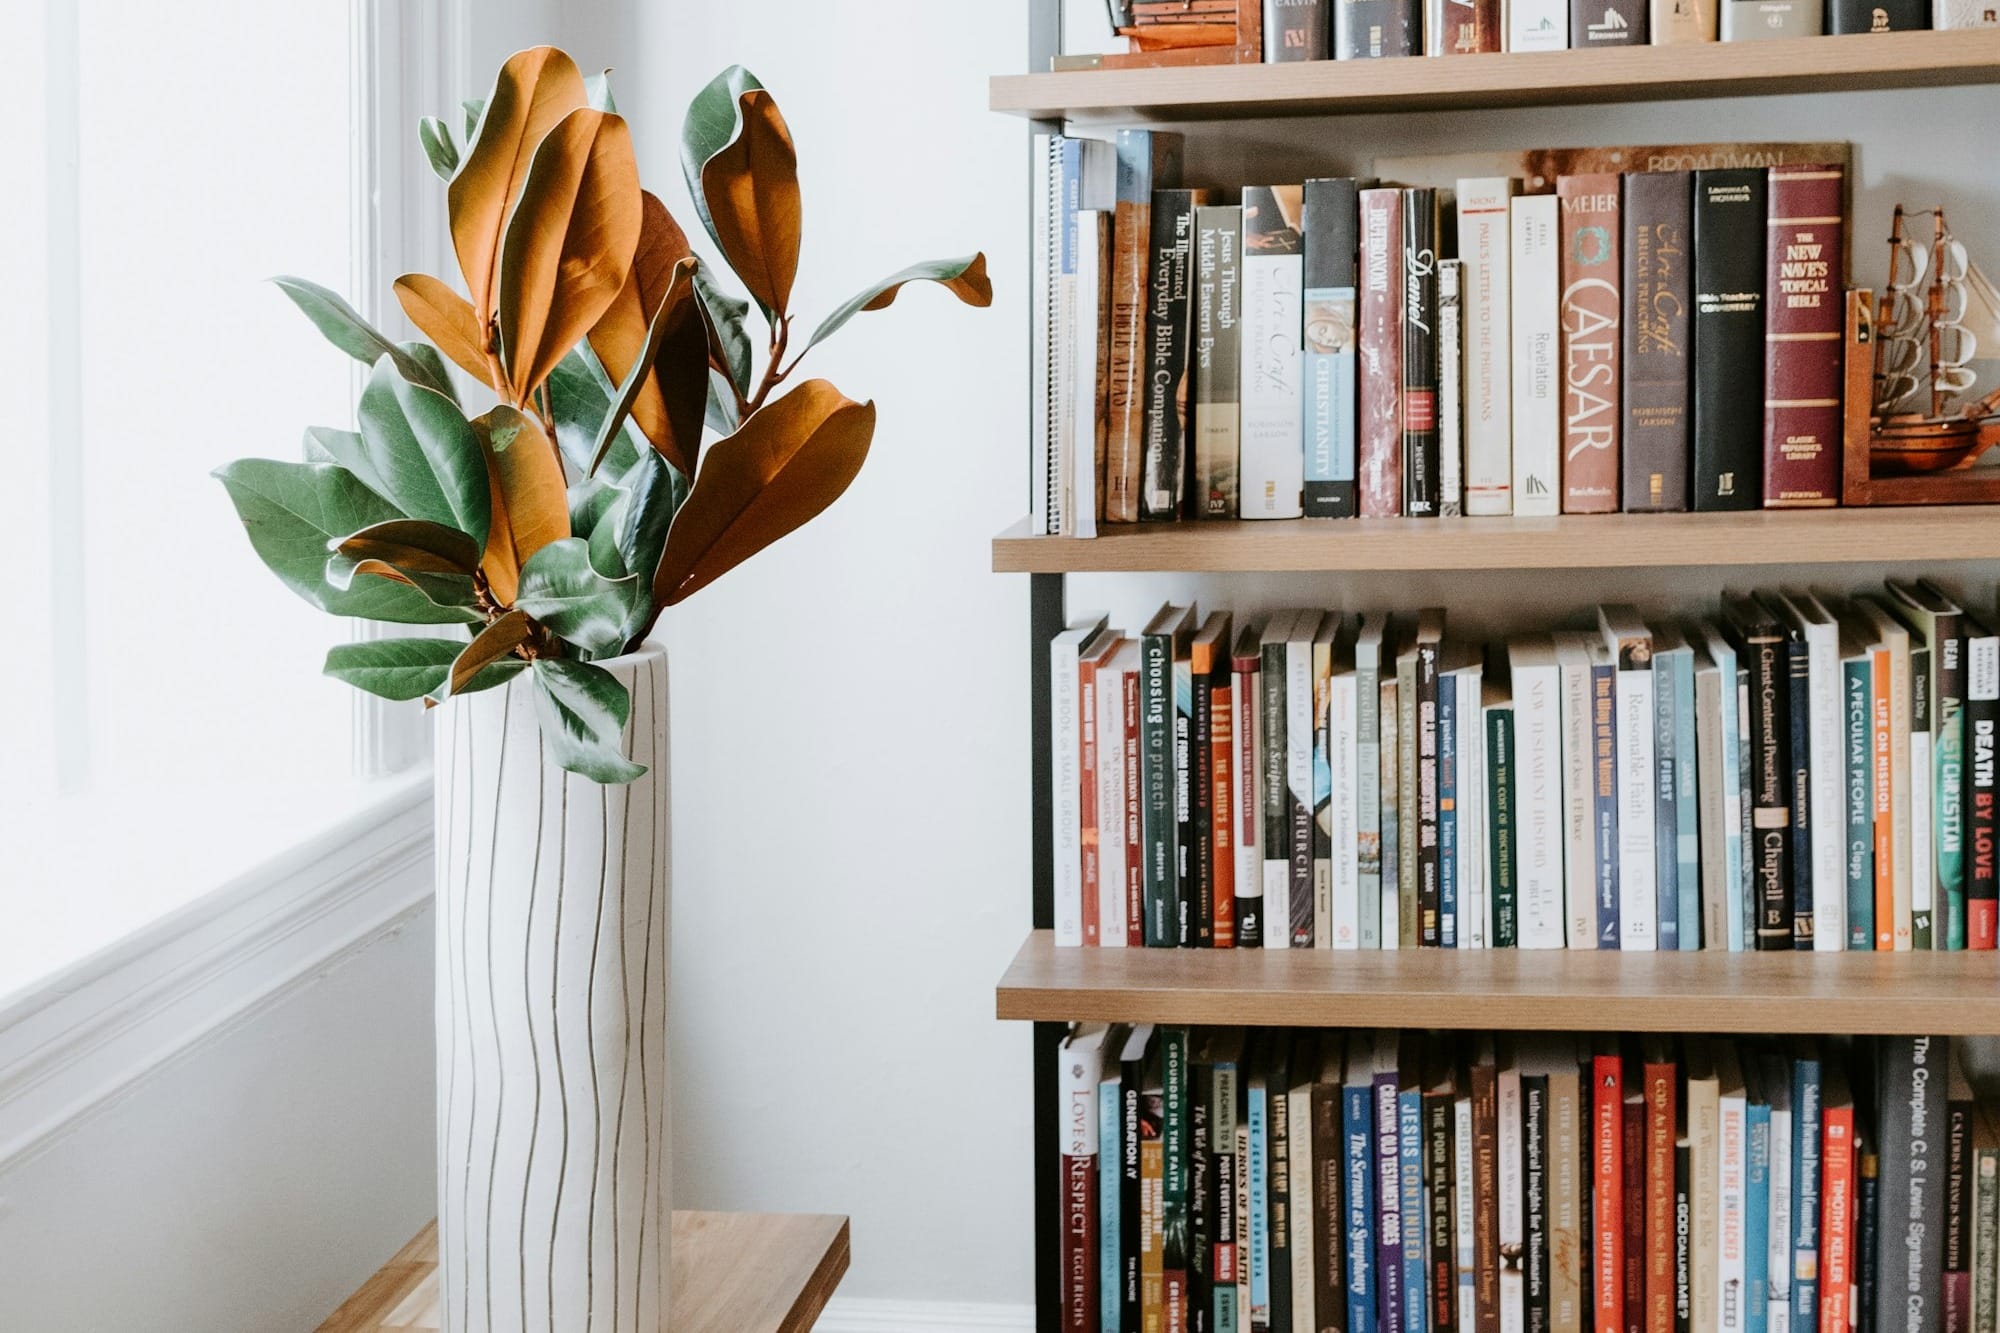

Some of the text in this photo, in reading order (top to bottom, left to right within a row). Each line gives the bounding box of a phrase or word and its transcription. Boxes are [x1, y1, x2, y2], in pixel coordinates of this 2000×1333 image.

[1561, 194, 1618, 214] MEIER
[1786, 245, 1823, 261] NEW
[1796, 233, 1814, 244] THE
[1174, 213, 1190, 300] The Illustrated
[1197, 229, 1215, 369] Middle Eastern Eyes
[1218, 228, 1236, 329] Jesus Through
[1406, 247, 1434, 335] Daniel
[1780, 262, 1829, 279] NAVE'S
[1780, 280, 1829, 294] TOPICAL
[1787, 295, 1821, 309] BIBLE
[1150, 247, 1176, 464] Everyday Bible Companion
[1536, 333, 1551, 399] Revelation
[1561, 278, 1619, 463] CAESAR
[1315, 358, 1330, 476] CHRISTIANITY
[1913, 675, 1927, 719] David Day
[1943, 638, 1958, 669] DEAN
[1147, 648, 1167, 811] choosing to preach
[1177, 717, 1189, 822] OUT FROM DARKNESS
[1242, 703, 1252, 819] GROWING TRUE DISCIPLES
[1267, 686, 1283, 807] The Drama of Scripture
[1338, 731, 1349, 782] Documents
[1358, 670, 1376, 829] Preaching the Parables
[1567, 672, 1583, 790] The Hard Sayings of Jesus
[1594, 676, 1613, 797] The Way of the Master
[1628, 693, 1645, 820] Reasonable Faith
[1658, 670, 1674, 801] KINGDOM FIRST
[1760, 648, 1779, 803] Christ-Centered Preaching
[1850, 677, 1865, 826] A PECULIAR PEOPLE
[1876, 698, 1890, 813] LIFE ON MISSION
[1942, 696, 1961, 853] ALMOST CHRISTIAN
[1216, 759, 1229, 848] THE MASTER'S MEN
[1339, 793, 1350, 807] the
[1339, 808, 1350, 852] Christian
[1402, 701, 1414, 889] A SHORT HISTORY OF THE EARLY CHURCH
[1974, 719, 1994, 881] DEATH BY LOVE
[1340, 853, 1350, 886] Church
[1424, 862, 1434, 893] BOMAR
[1760, 831, 1783, 901] Chapell
[1848, 840, 1865, 880] Clapp
[1218, 1073, 1230, 1126] PREACHING
[1908, 1067, 1930, 1137] Complete
[1912, 1036, 1930, 1065] The
[1071, 1090, 1092, 1238] LOVE & RESPECT
[1168, 1043, 1179, 1192] GROUNDED IN THE FAITH
[1191, 1104, 1207, 1212] The Web of Preaching
[1219, 1128, 1230, 1142] TO
[1379, 1083, 1400, 1247] CRACKING OLD TESTAMENT CODES
[1910, 1157, 1928, 1176] S.
[1911, 1139, 1928, 1157] C.
[1219, 1155, 1231, 1241] POST-EVERYTHING
[1237, 1134, 1249, 1286] HEROES OF THE FAITH
[1350, 1132, 1369, 1296] The Sermon as Symphony
[1402, 1104, 1422, 1280] JESUS CONTINUED...
[1432, 1105, 1448, 1248] THE POOR WILL BE GLAD
[1459, 1112, 1472, 1235] CHRISTIAN BELIEFS
[1527, 1088, 1543, 1297] Anthropological Insights for Missionaries
[1699, 1104, 1713, 1248] Lost Women of the Bible
[1724, 1110, 1740, 1261] REACHING THE UNREACHED
[1909, 1177, 1926, 1220] Lewis
[1220, 1244, 1231, 1280] WORLD
[1830, 1178, 1846, 1284] TIMOTHY KELLER
[1905, 1221, 1926, 1292] Signature
[1072, 1247, 1085, 1327] EGGERICHS
[1220, 1293, 1231, 1328] ESWINE
